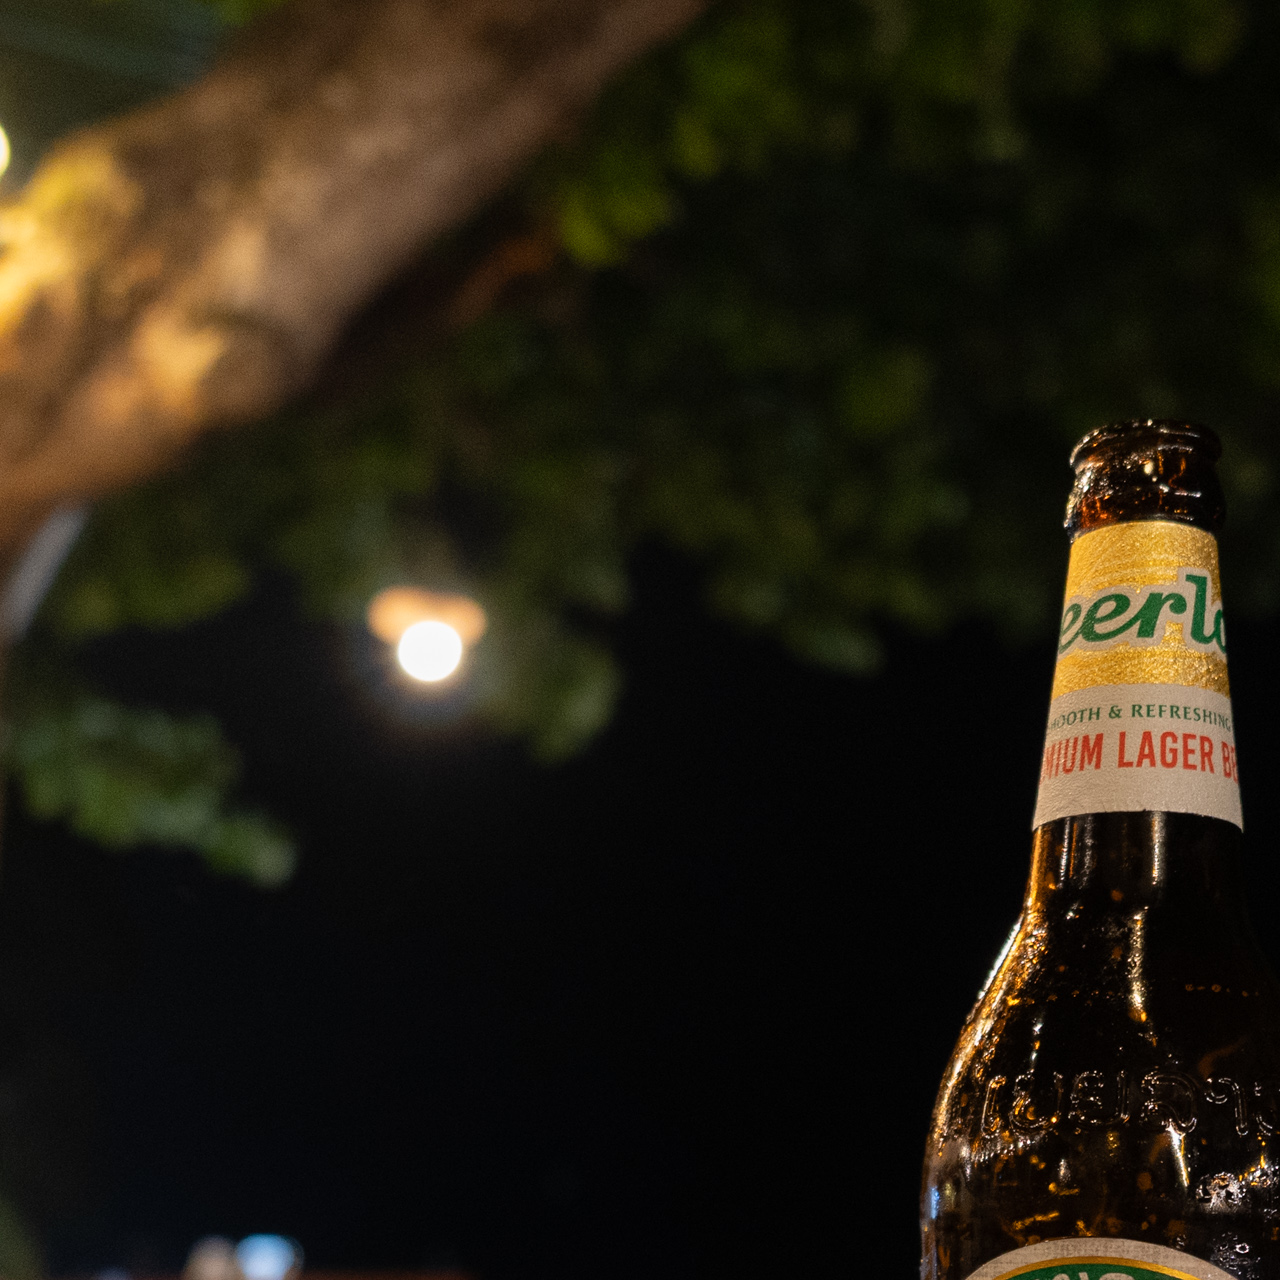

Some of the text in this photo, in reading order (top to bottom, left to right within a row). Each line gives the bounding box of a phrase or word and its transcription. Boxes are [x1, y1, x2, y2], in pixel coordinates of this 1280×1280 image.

[1058, 574, 1226, 654] eerl
[1108, 705, 1123, 719] &
[1131, 704, 1232, 732] REFRESHING
[1042, 732, 1104, 781] MIUM
[1117, 730, 1215, 775] LAGER
